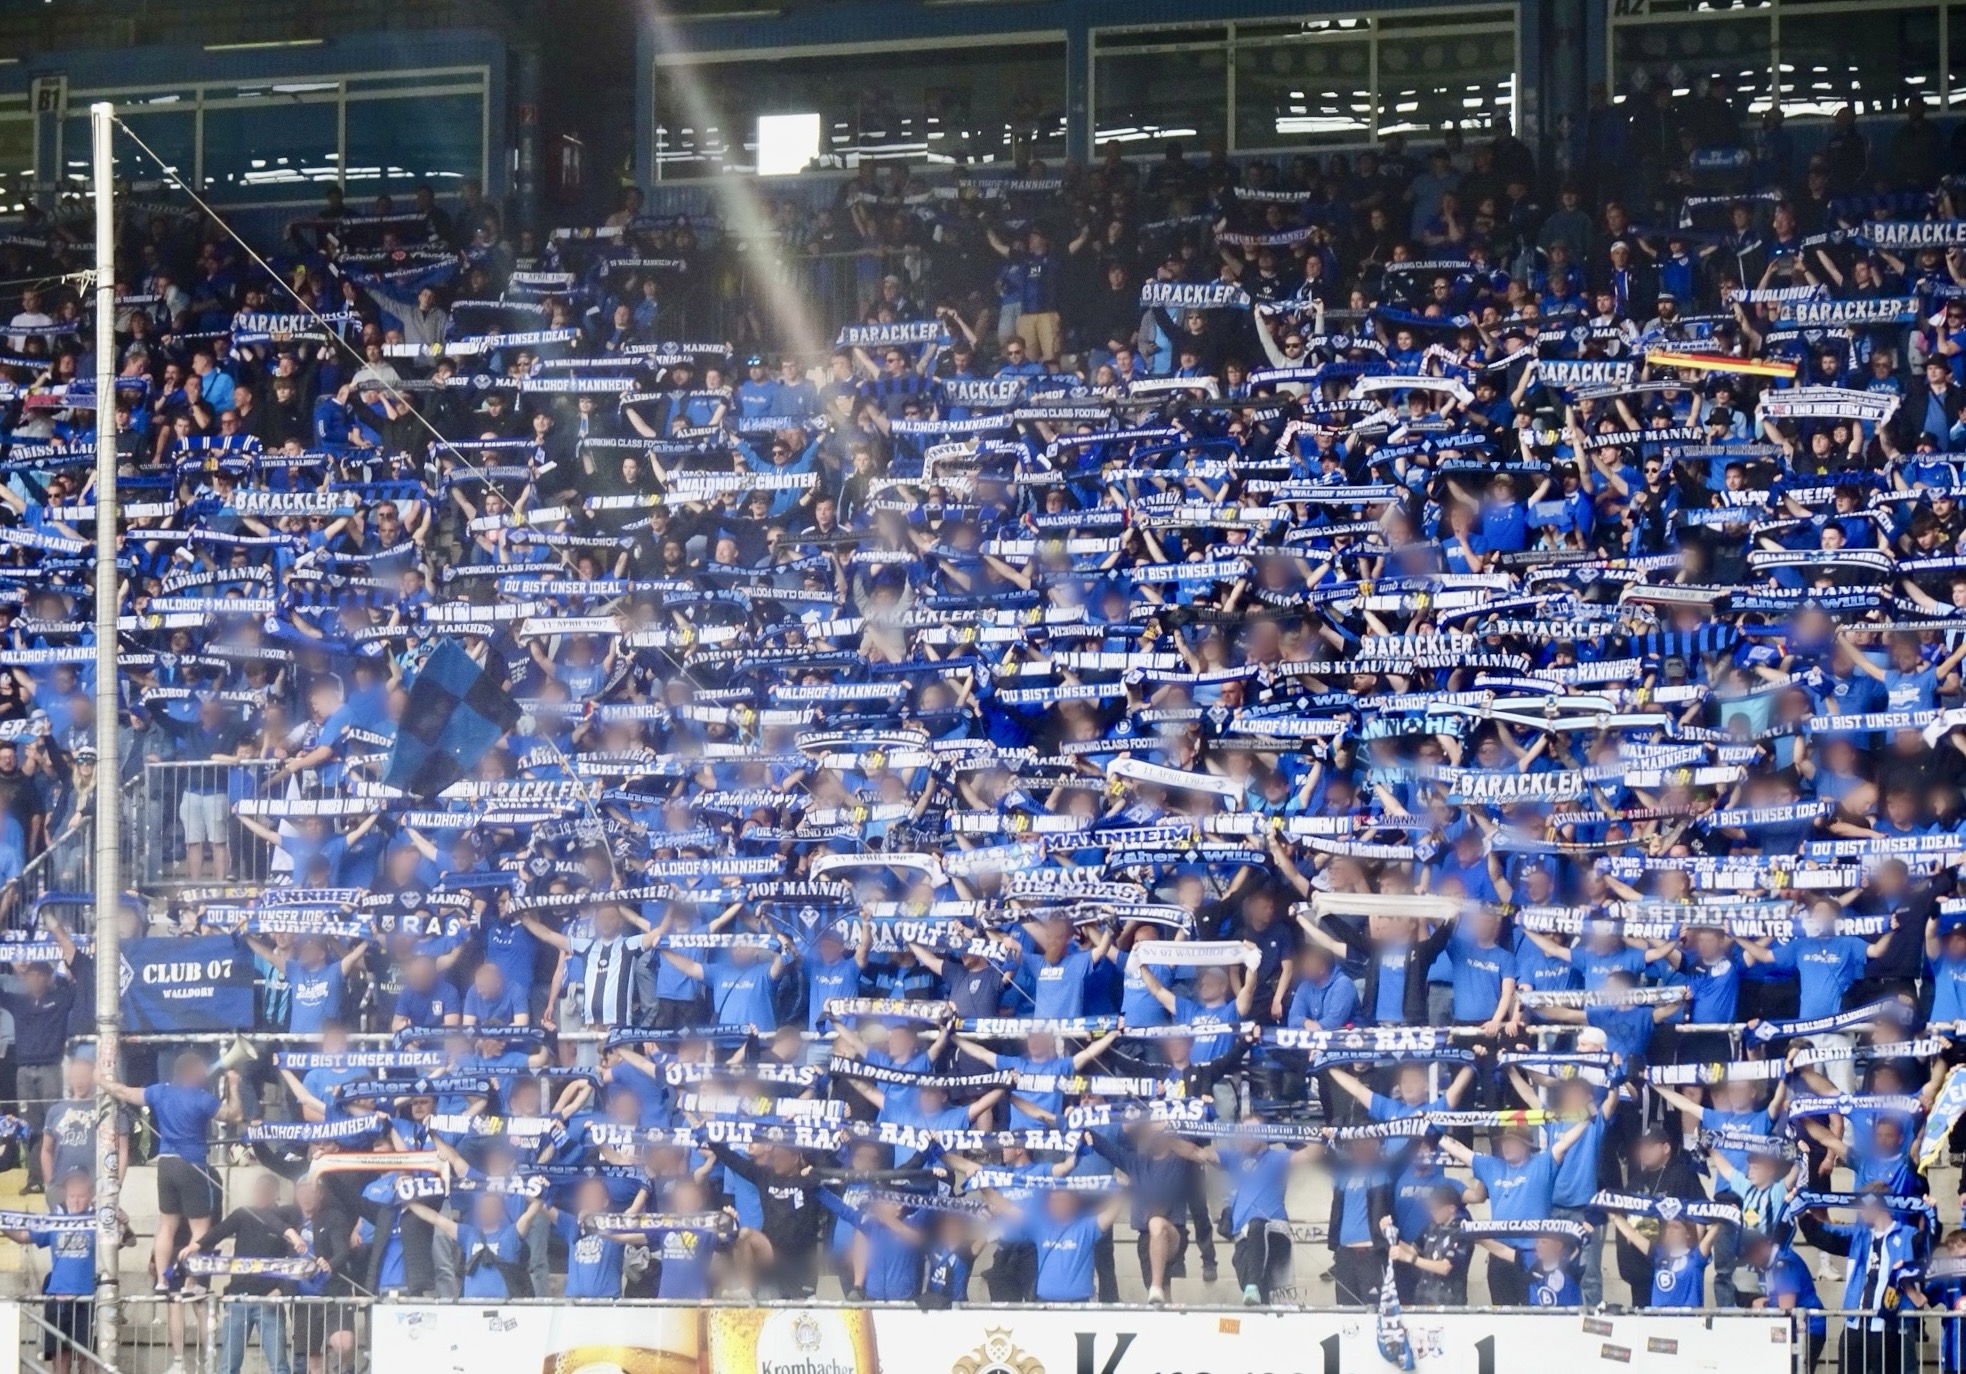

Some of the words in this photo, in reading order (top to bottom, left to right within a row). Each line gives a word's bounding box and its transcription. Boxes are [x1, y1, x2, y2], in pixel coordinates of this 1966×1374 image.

[38, 89, 59, 111] B1
[1011, 179, 1062, 190] MANNHEIM
[1142, 283, 1234, 304] BARACKLER
[1797, 299, 1901, 321] BARACKLER
[508, 332, 539, 344] UNSER
[541, 330, 570, 342] IDEAL
[849, 322, 937, 342] BARACKLER
[588, 358, 630, 366] MANNHEIM
[1259, 369, 1291, 382] WALDHOF
[523, 380, 568, 392] WALDHOF
[578, 379, 633, 391] MANNHEIM
[947, 380, 1020, 400] RACKLER
[1048, 408, 1071, 419] CLASS
[1813, 405, 1838, 415] HASS
[892, 419, 942, 433] WALDHOF
[949, 416, 1004, 431] MANNHEIM
[678, 476, 742, 491] WALDHOF
[755, 473, 818, 490] CHAOTEN
[1015, 472, 1063, 482] MANNHEIM
[1291, 488, 1334, 499] WALDHOF
[1337, 486, 1388, 498] MANNHEIM
[236, 492, 340, 510] BARACKLER
[1036, 513, 1122, 527] WALDHOF-POWER
[205, 531, 239, 543] WALDHOF
[1323, 526, 1347, 537] CLASS
[45, 536, 83, 553] MANNH
[529, 534, 544, 544] WIR
[547, 535, 568, 545] SIND
[570, 536, 618, 547] WALDHOF
[990, 540, 999, 554] SV
[1002, 540, 1035, 554] WALDHOF
[1067, 538, 1106, 553] MANNHEIM
[1108, 538, 1120, 551] 07
[1214, 546, 1255, 558] LOYAL
[1258, 546, 1275, 556] TO
[1278, 547, 1297, 558] THE
[1754, 551, 1805, 564] WALDHOF
[458, 565, 491, 576] WORKING
[1147, 567, 1174, 581] BIST
[1177, 563, 1216, 579] UNSER
[504, 580, 518, 593] DU
[522, 580, 547, 593] BIST
[551, 581, 586, 594] UNSER
[590, 581, 622, 594] IDEAL
[1330, 588, 1358, 601] immer
[1378, 581, 1400, 593] und
[152, 599, 203, 610] WALDHOF
[214, 600, 275, 611] MANNHEIM
[1732, 596, 1801, 610] Zäher
[1822, 595, 1880, 608] Wille
[446, 606, 453, 620] IN
[436, 623, 494, 638] MANNHEIM
[554, 620, 582, 629] APRIL
[1367, 635, 1473, 656] BARACKLER
[57, 648, 96, 660] MANNH
[776, 684, 829, 700] WALDHOF
[840, 683, 901, 698] MANNHEIM
[1002, 690, 1018, 701] DU
[1022, 688, 1051, 700] BIST
[1055, 686, 1091, 699] UNSER
[1811, 715, 1826, 730] DU
[1830, 714, 1863, 729] BIST
[1866, 713, 1911, 728] UNSER
[1062, 741, 1102, 755] WORKING
[1104, 740, 1128, 751] CLASS
[1637, 747, 1702, 770] MANNHEIM
[578, 762, 667, 776] KURPFALZ
[1461, 771, 1581, 794] BARACKLER
[239, 800, 257, 814] ARM
[259, 800, 268, 814] IN
[270, 800, 288, 814] ARM
[290, 800, 316, 814] DURCH
[318, 800, 342, 814] UNSER
[343, 799, 365, 813] LAND
[411, 813, 464, 827] WALDHOF
[1032, 815, 1077, 832] MANNHEIM
[1721, 810, 1748, 826] BIST
[1752, 806, 1794, 825] UNSER
[1203, 818, 1212, 833] SV
[1214, 817, 1254, 833] WALDHOF
[1289, 817, 1333, 834] MANNHEIM
[1337, 817, 1348, 833] 07
[1044, 826, 1191, 852] MANNHEIM
[1812, 841, 1831, 856] DU
[1835, 840, 1866, 855] BIST
[1870, 837, 1918, 853] UNSER
[1921, 834, 1963, 849] IDEAL
[1351, 843, 1414, 859] Mannheim
[712, 858, 779, 873] MANNHEIM
[1702, 871, 1713, 889] SV
[1715, 870, 1756, 889] WALDHOF
[1793, 870, 1842, 887] MANNHEIM
[1844, 869, 1857, 887] 07
[208, 910, 224, 923] DU
[228, 910, 254, 923] BIST
[259, 921, 362, 937] KURPFALZ
[1523, 914, 1584, 933] WALTER
[1623, 923, 1673, 939] PRADT
[1732, 920, 1793, 937] WALTER
[1834, 918, 1884, 935] PRADT
[669, 934, 771, 949] KURPFALZ
[143, 962, 202, 983] CLUB
[208, 960, 233, 979] 07
[163, 988, 214, 998] WALLDORF
[977, 1017, 1086, 1033] KURPFALZ
[1783, 1024, 1793, 1034] SV
[1795, 1016, 1834, 1032] WALDHOF
[1277, 1030, 1332, 1049] ULT
[1376, 1028, 1436, 1050] RAS
[287, 1053, 307, 1067] DU
[310, 1053, 343, 1067] BIST
[348, 1053, 393, 1067] UNSER
[399, 1052, 440, 1065] IDEAL
[666, 1064, 715, 1084] ULT
[830, 1056, 917, 1085] WALDHOF
[1652, 1065, 1661, 1083] SV
[1728, 1060, 1768, 1080] MANNHEIM
[1769, 1059, 1781, 1078] 07
[1091, 1076, 1139, 1095] MANNHEIM
[1141, 1078, 1153, 1096] 07
[699, 1095, 740, 1113] WALDHOF
[248, 1125, 302, 1141] WALDHOF
[312, 1117, 378, 1139] MANNHEIM
[591, 1125, 636, 1145] ULT
[708, 1122, 755, 1142] ULT
[880, 1122, 931, 1151] RAS
[1341, 1118, 1430, 1140] MANNHEIM
[939, 1130, 985, 1151] ULT
[1025, 1130, 1081, 1152] RAS
[1464, 1219, 1507, 1233] WORKING
[1508, 1219, 1539, 1232] CLASS
[761, 1359, 855, 1374] Krombacher
